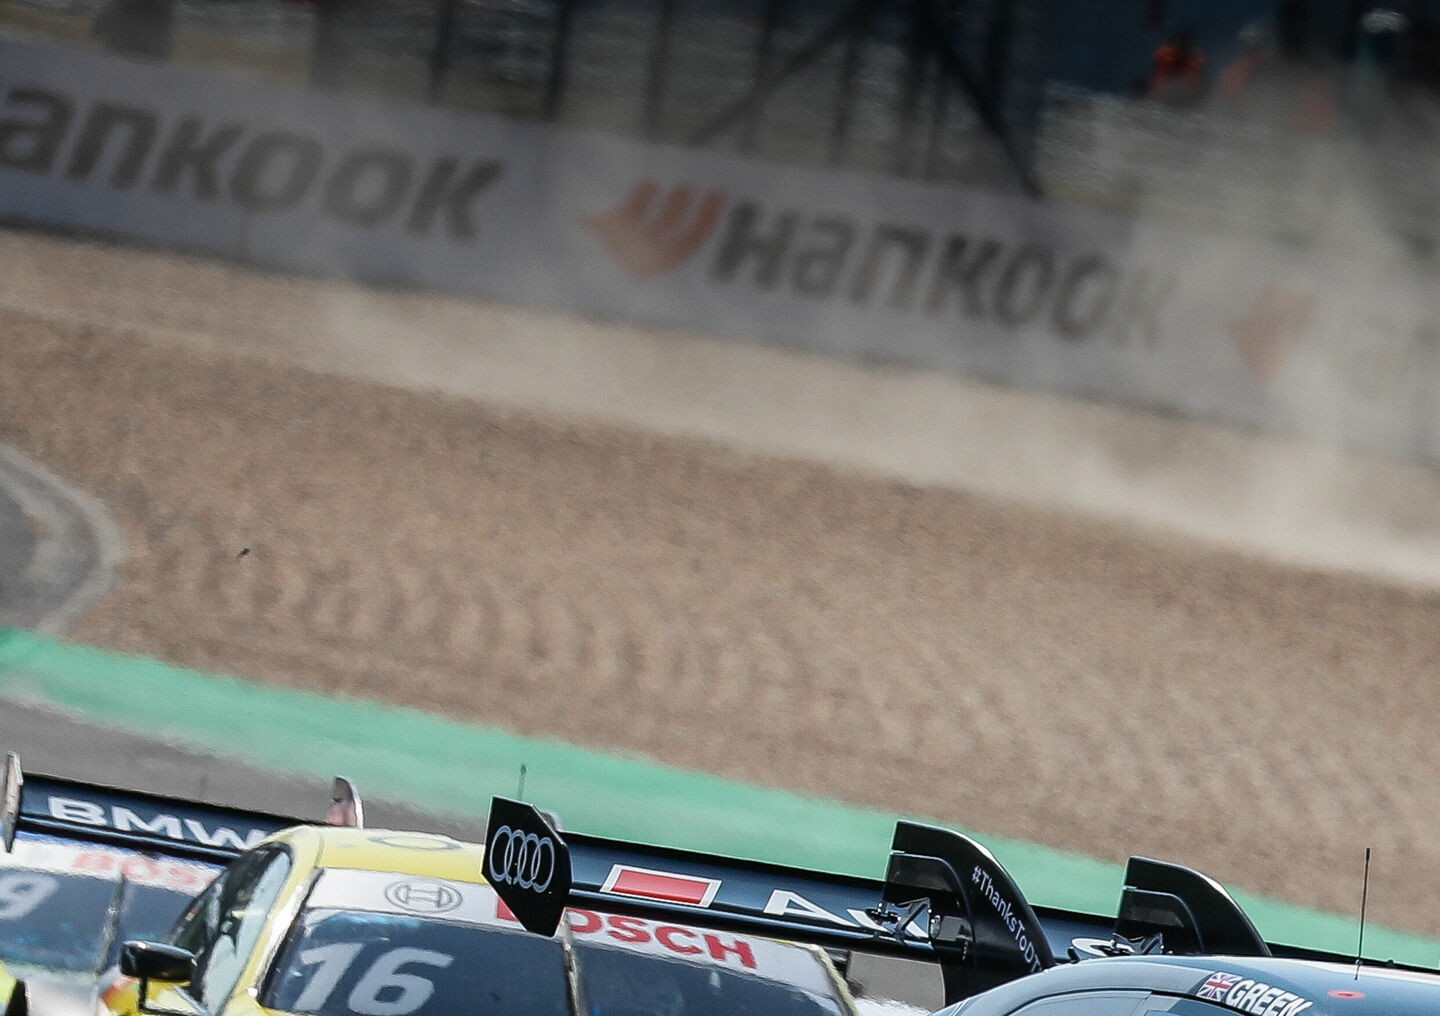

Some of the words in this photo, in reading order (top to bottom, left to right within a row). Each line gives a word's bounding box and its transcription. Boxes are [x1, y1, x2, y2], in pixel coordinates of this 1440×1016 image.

[47, 795, 268, 851] BMW
[971, 865, 1045, 973] #ThanksToDT
[301, 943, 454, 1016] 16
